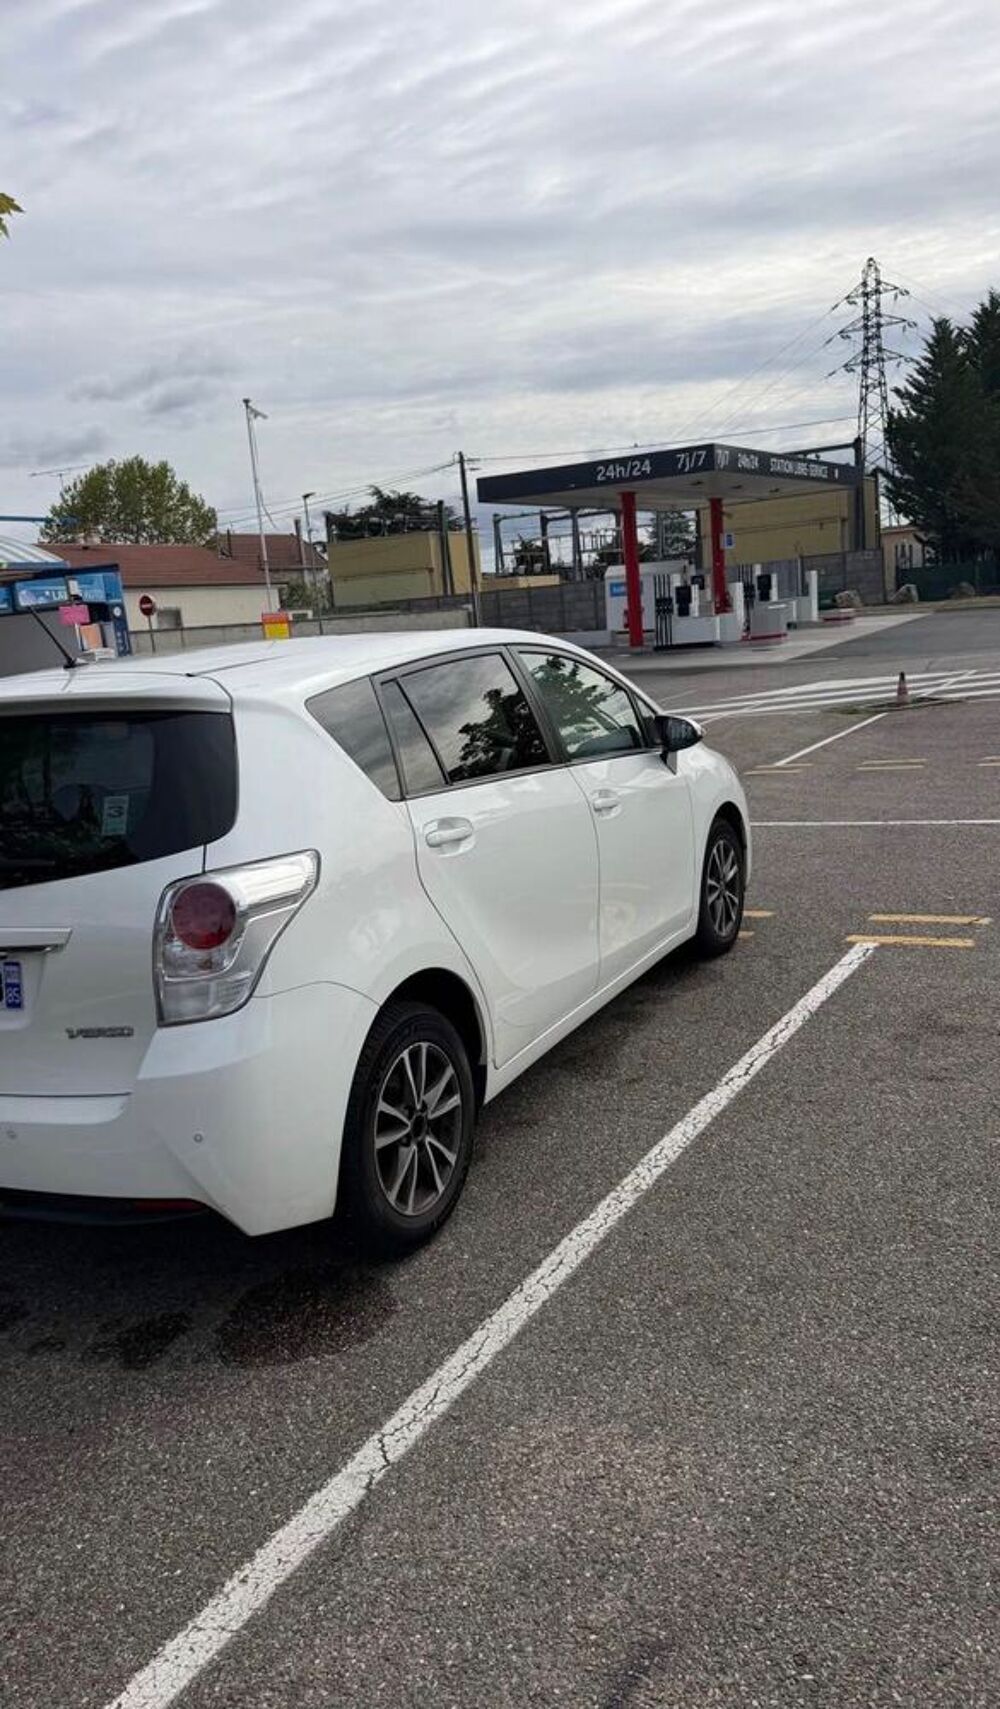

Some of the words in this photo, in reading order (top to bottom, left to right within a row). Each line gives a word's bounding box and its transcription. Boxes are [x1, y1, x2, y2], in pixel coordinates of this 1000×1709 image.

[596, 459, 651, 481] 24h/24
[676, 450, 706, 472] 7j/7
[65, 1026, 135, 1039] VERSO
